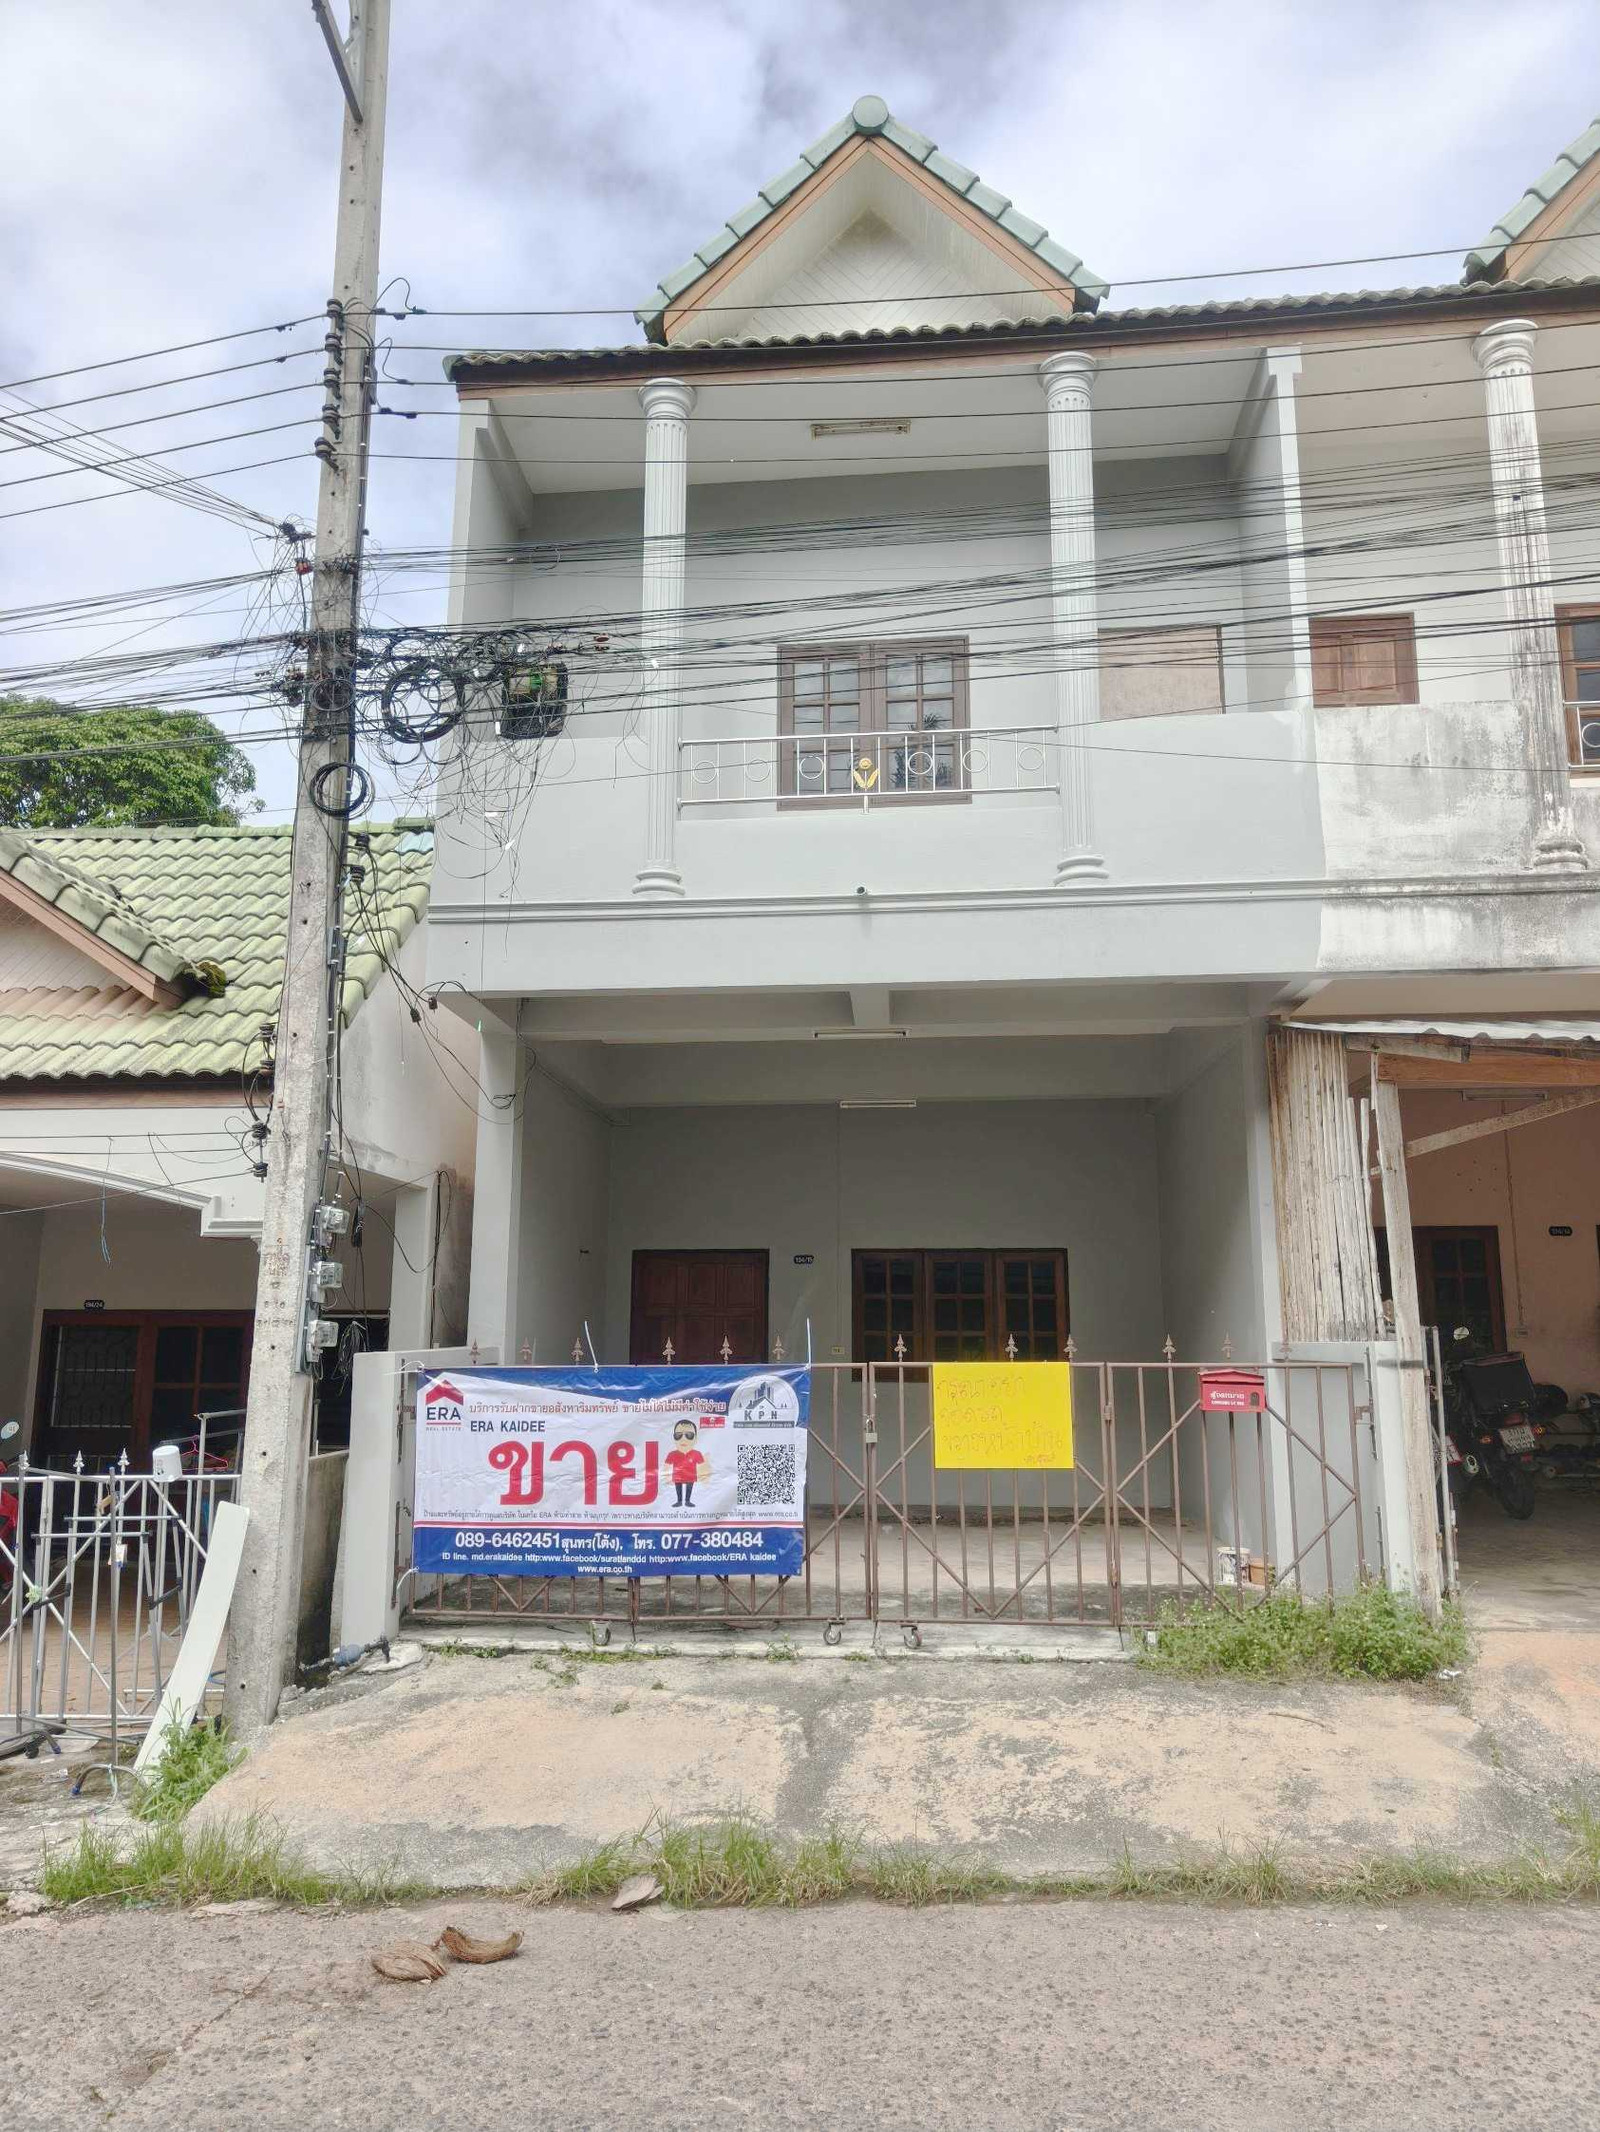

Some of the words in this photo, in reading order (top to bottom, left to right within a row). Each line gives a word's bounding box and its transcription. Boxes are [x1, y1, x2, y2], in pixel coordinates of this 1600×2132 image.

[426, 1407, 461, 1420] ERA
[470, 1421, 494, 1432] ERA
[500, 1421, 546, 1432] KAIDEE
[488, 1440, 659, 1505] ขาย
[632, 1533, 656, 1549] โทร.
[660, 1531, 763, 1549] 077-380484
[442, 1552, 450, 1560] ID
[577, 1565, 633, 1574] www.era.co.th
